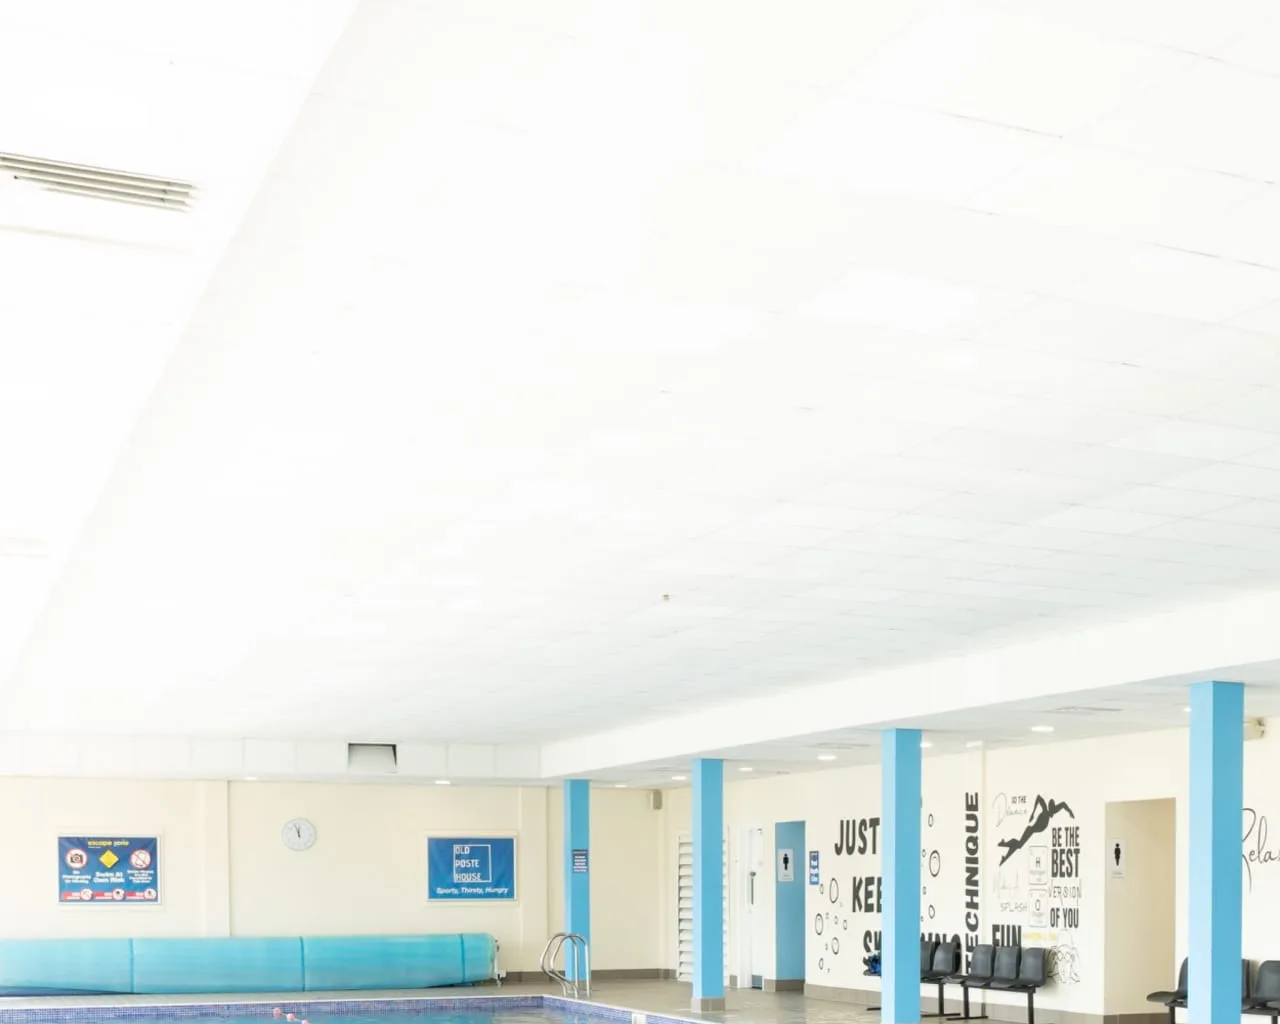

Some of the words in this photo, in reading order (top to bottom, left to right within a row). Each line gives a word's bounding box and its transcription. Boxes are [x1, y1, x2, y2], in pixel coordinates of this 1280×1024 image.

[834, 817, 881, 856] JUST
[1052, 827, 1062, 848] BE
[1064, 826, 1080, 847] THE
[455, 846, 470, 855] OLD
[1051, 848, 1081, 878] BEST
[455, 872, 482, 881] HOUSE
[965, 792, 979, 974] TECHNIQUE
[852, 876, 882, 913] KEE
[1050, 907, 1060, 928] OF
[1062, 907, 1079, 929] YOU
[992, 924, 1022, 947] FUN
